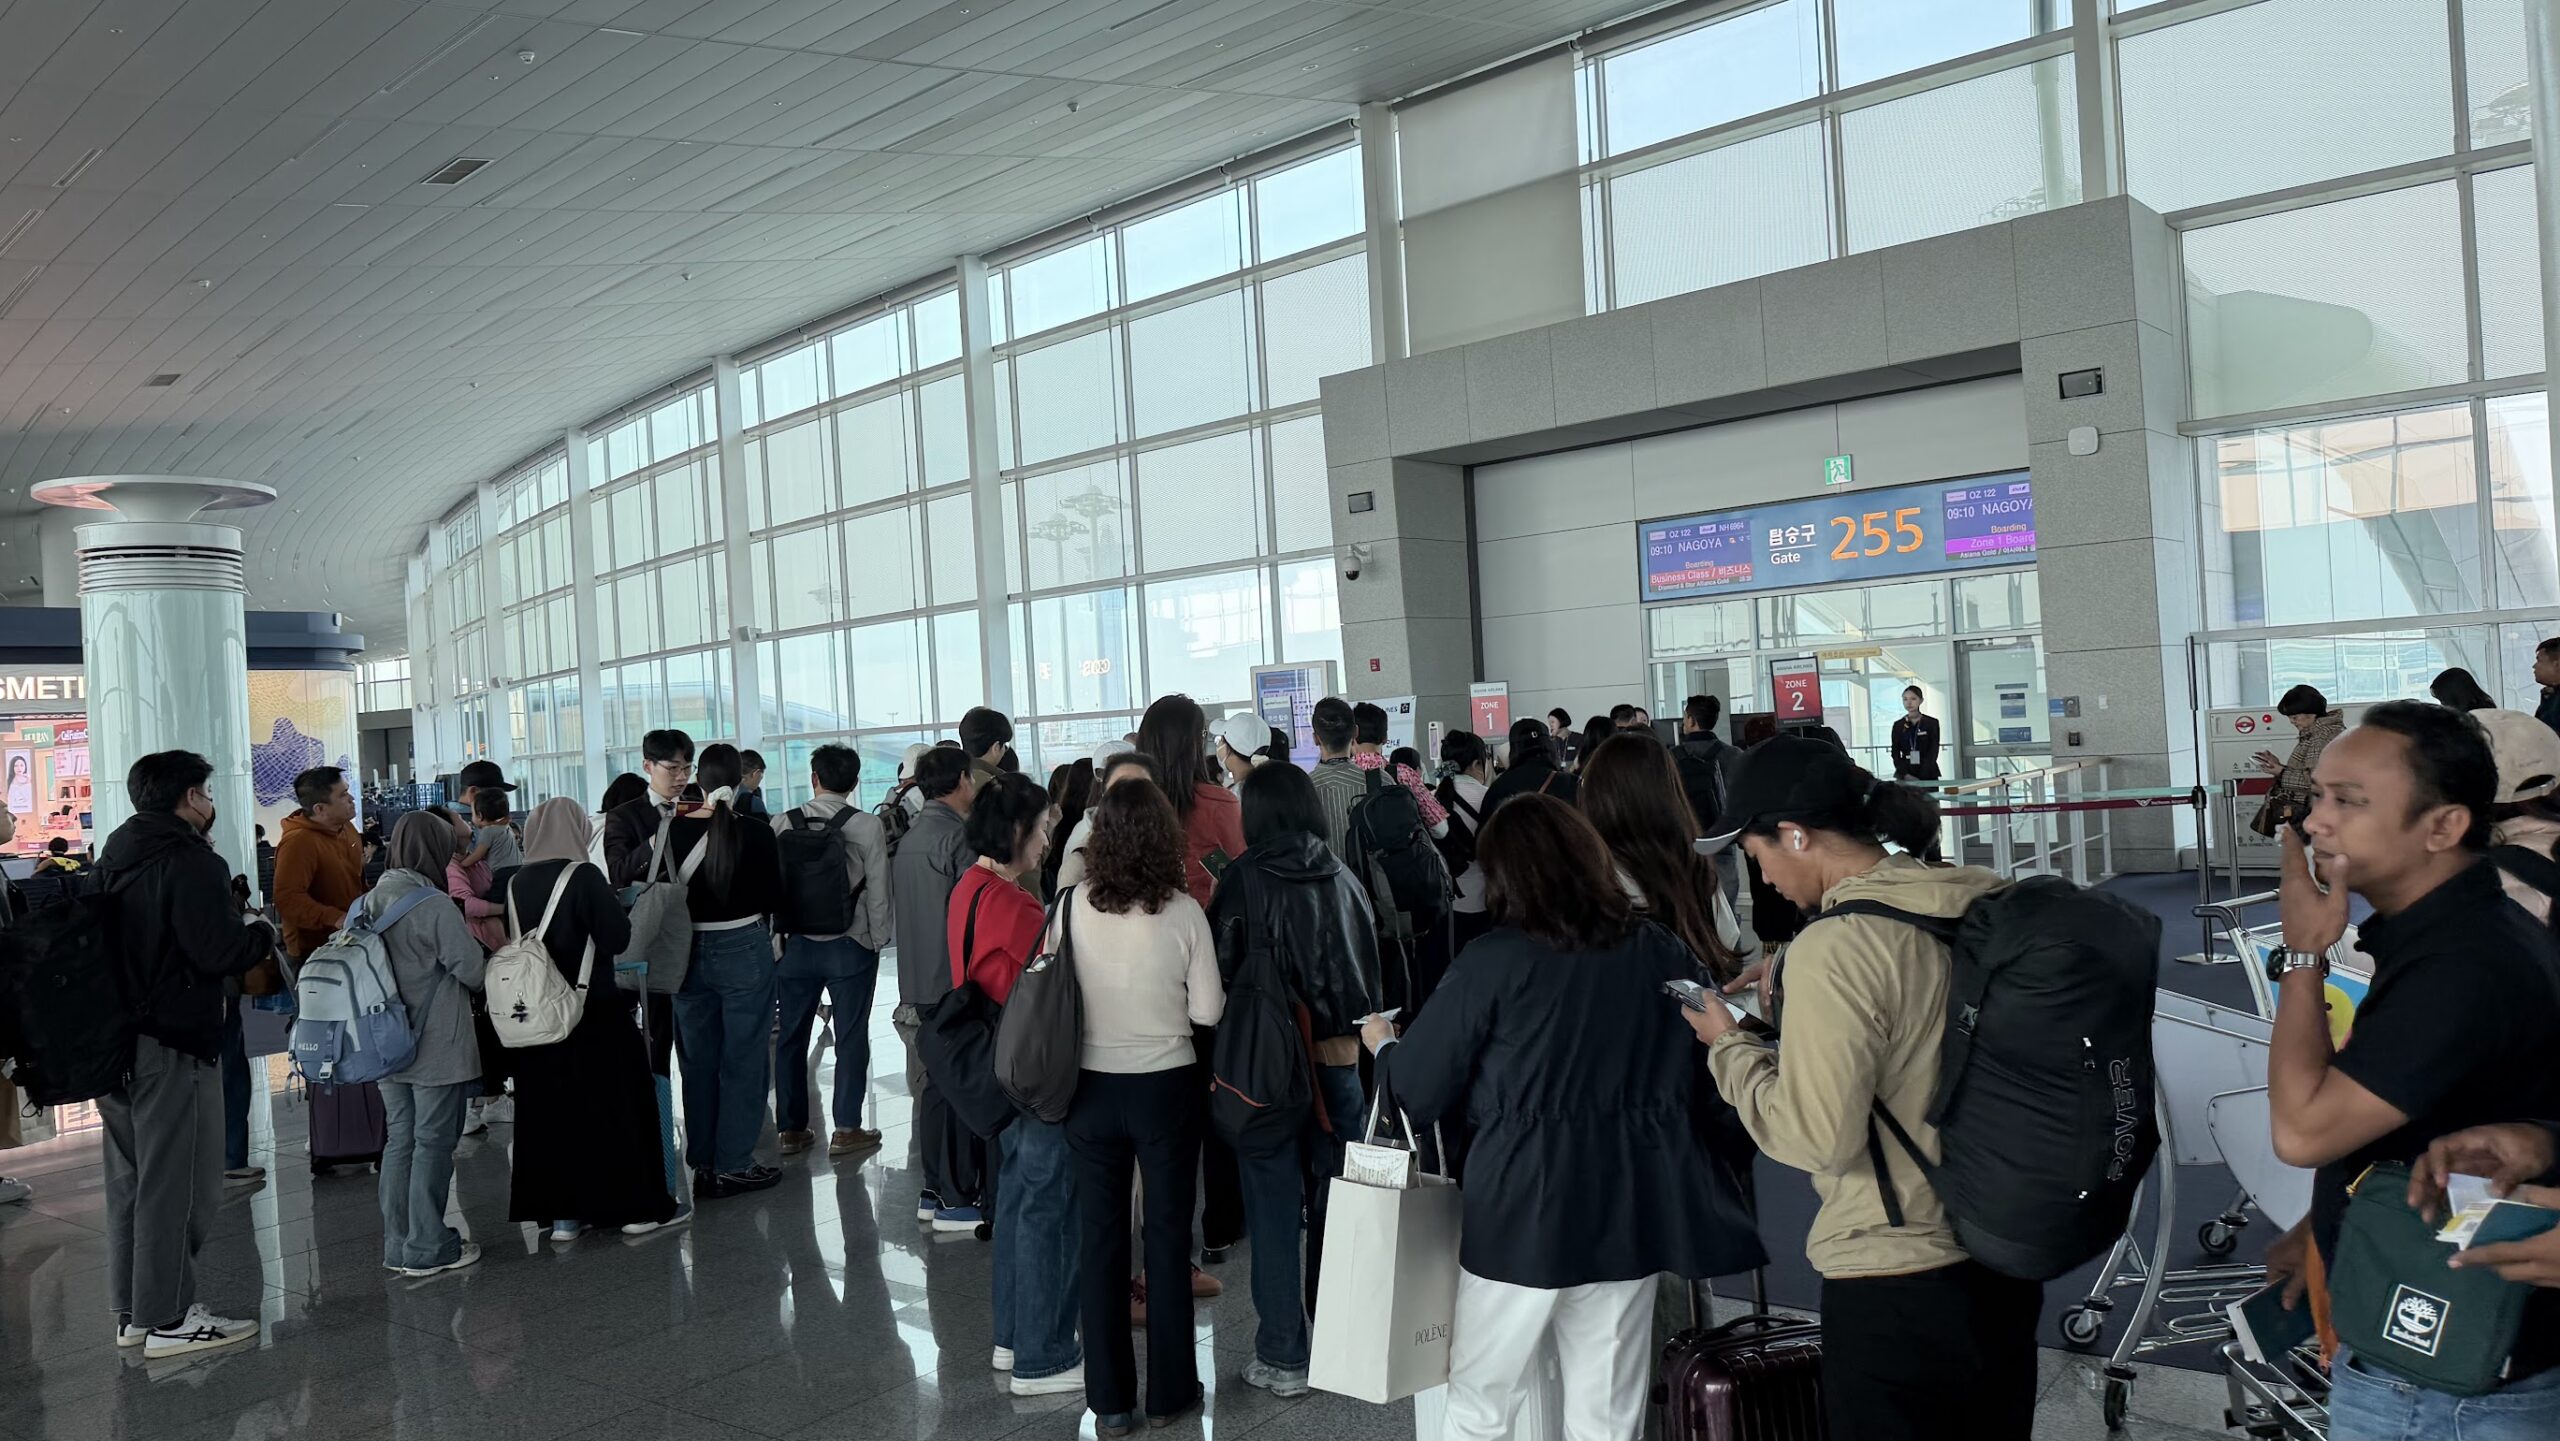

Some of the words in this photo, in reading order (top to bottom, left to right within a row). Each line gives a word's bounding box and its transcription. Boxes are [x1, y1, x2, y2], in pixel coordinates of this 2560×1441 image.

[1969, 491, 1981, 499] OZ
[1984, 488, 1996, 497] 122
[1947, 506, 1975, 519] 09:10
[1681, 529, 1691, 537] 122
[1830, 507, 1924, 561] 255
[1991, 523, 2027, 533] Boarding
[1769, 524, 1816, 546] 탑승구
[1650, 544, 1673, 556] 09:10
[1678, 537, 1722, 553] NAGOYA
[1970, 537, 1994, 548] Zone
[1685, 560, 1714, 569] Boarding
[1770, 553, 1801, 565] Gate
[1651, 573, 1686, 584] Business
[1687, 570, 1710, 580] Class
[1718, 564, 1751, 576] 비즈니스
[0, 676, 85, 700] METI
[1785, 679, 1808, 689] ZONE
[1480, 701, 1499, 710] ZONE
[1791, 691, 1805, 711] 2
[1486, 712, 1493, 730] 1
